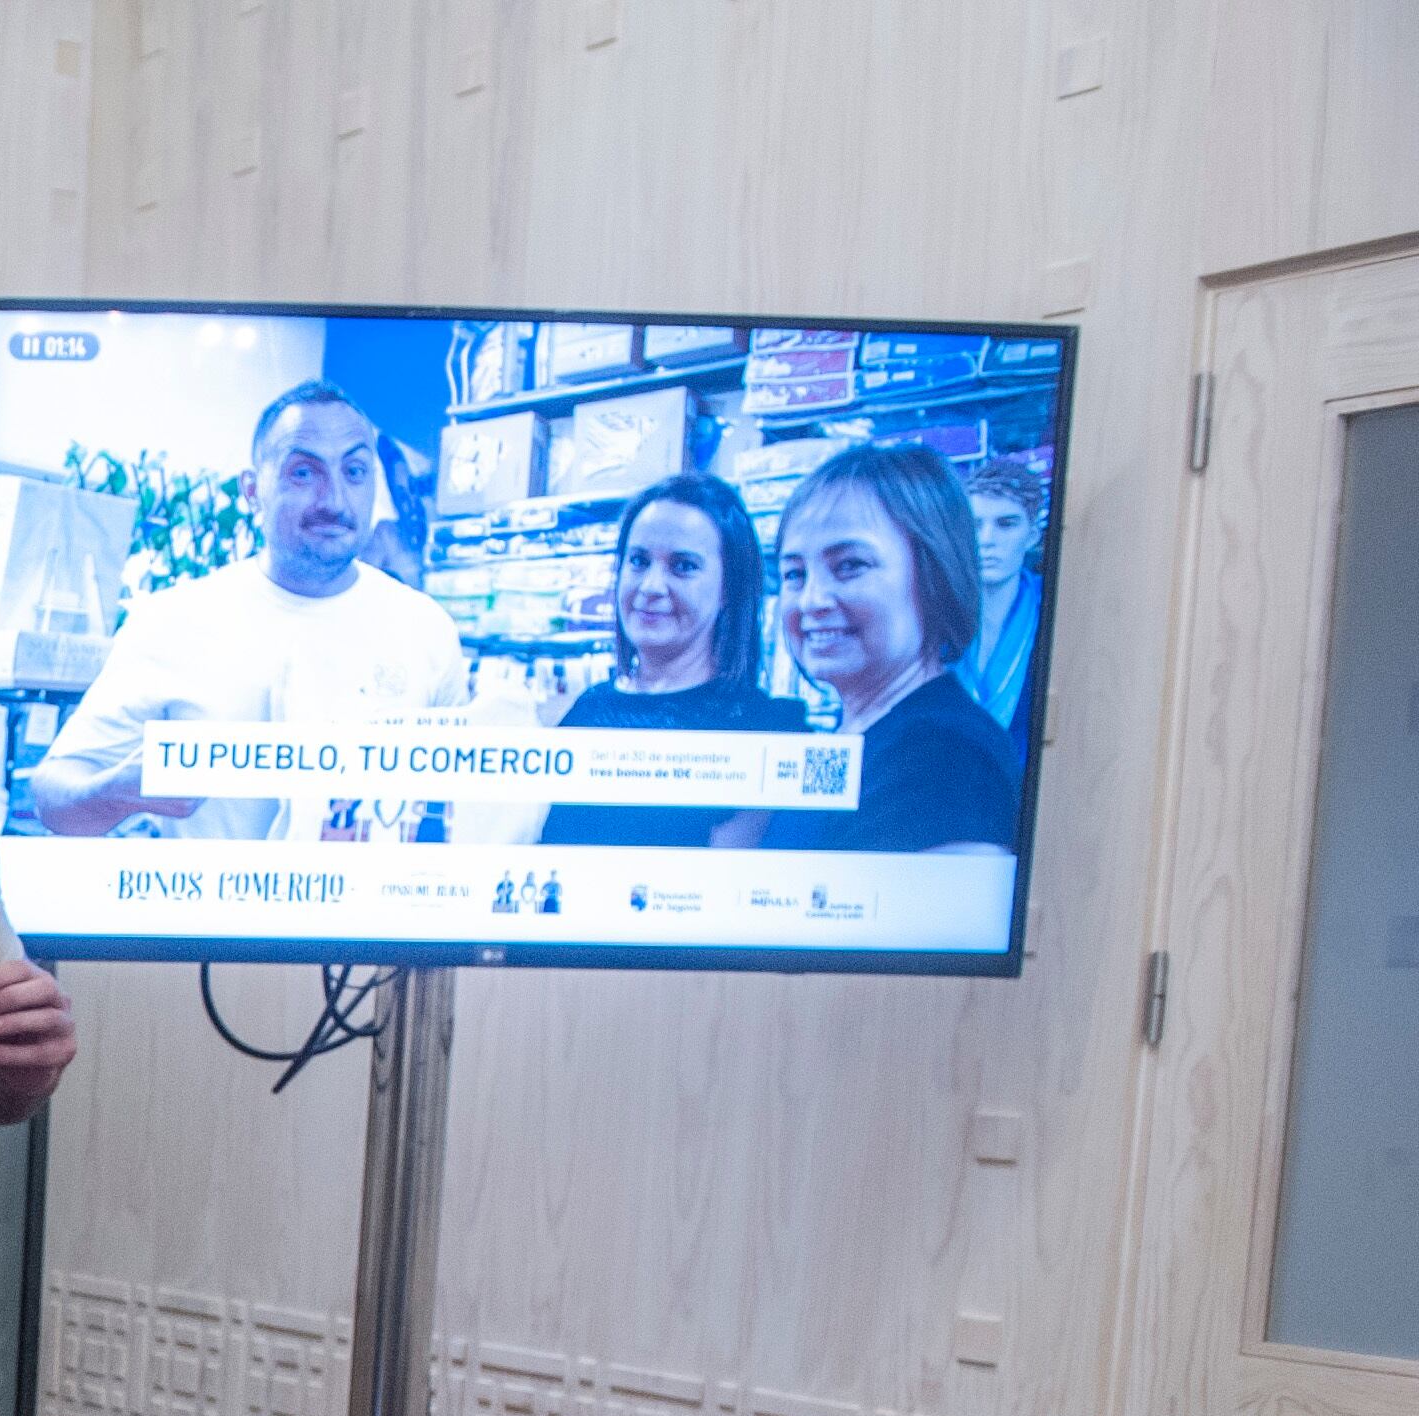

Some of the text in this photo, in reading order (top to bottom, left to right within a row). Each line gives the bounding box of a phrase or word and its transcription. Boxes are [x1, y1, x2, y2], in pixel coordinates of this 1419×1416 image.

[159, 742, 574, 776] TU PUEBLO, TU COMERCIO
[666, 751, 731, 764] septiembre
[590, 767, 613, 777] tres
[616, 768, 651, 778] bonos
[654, 768, 669, 779] de
[118, 870, 345, 903] BONOS COMERCIO
